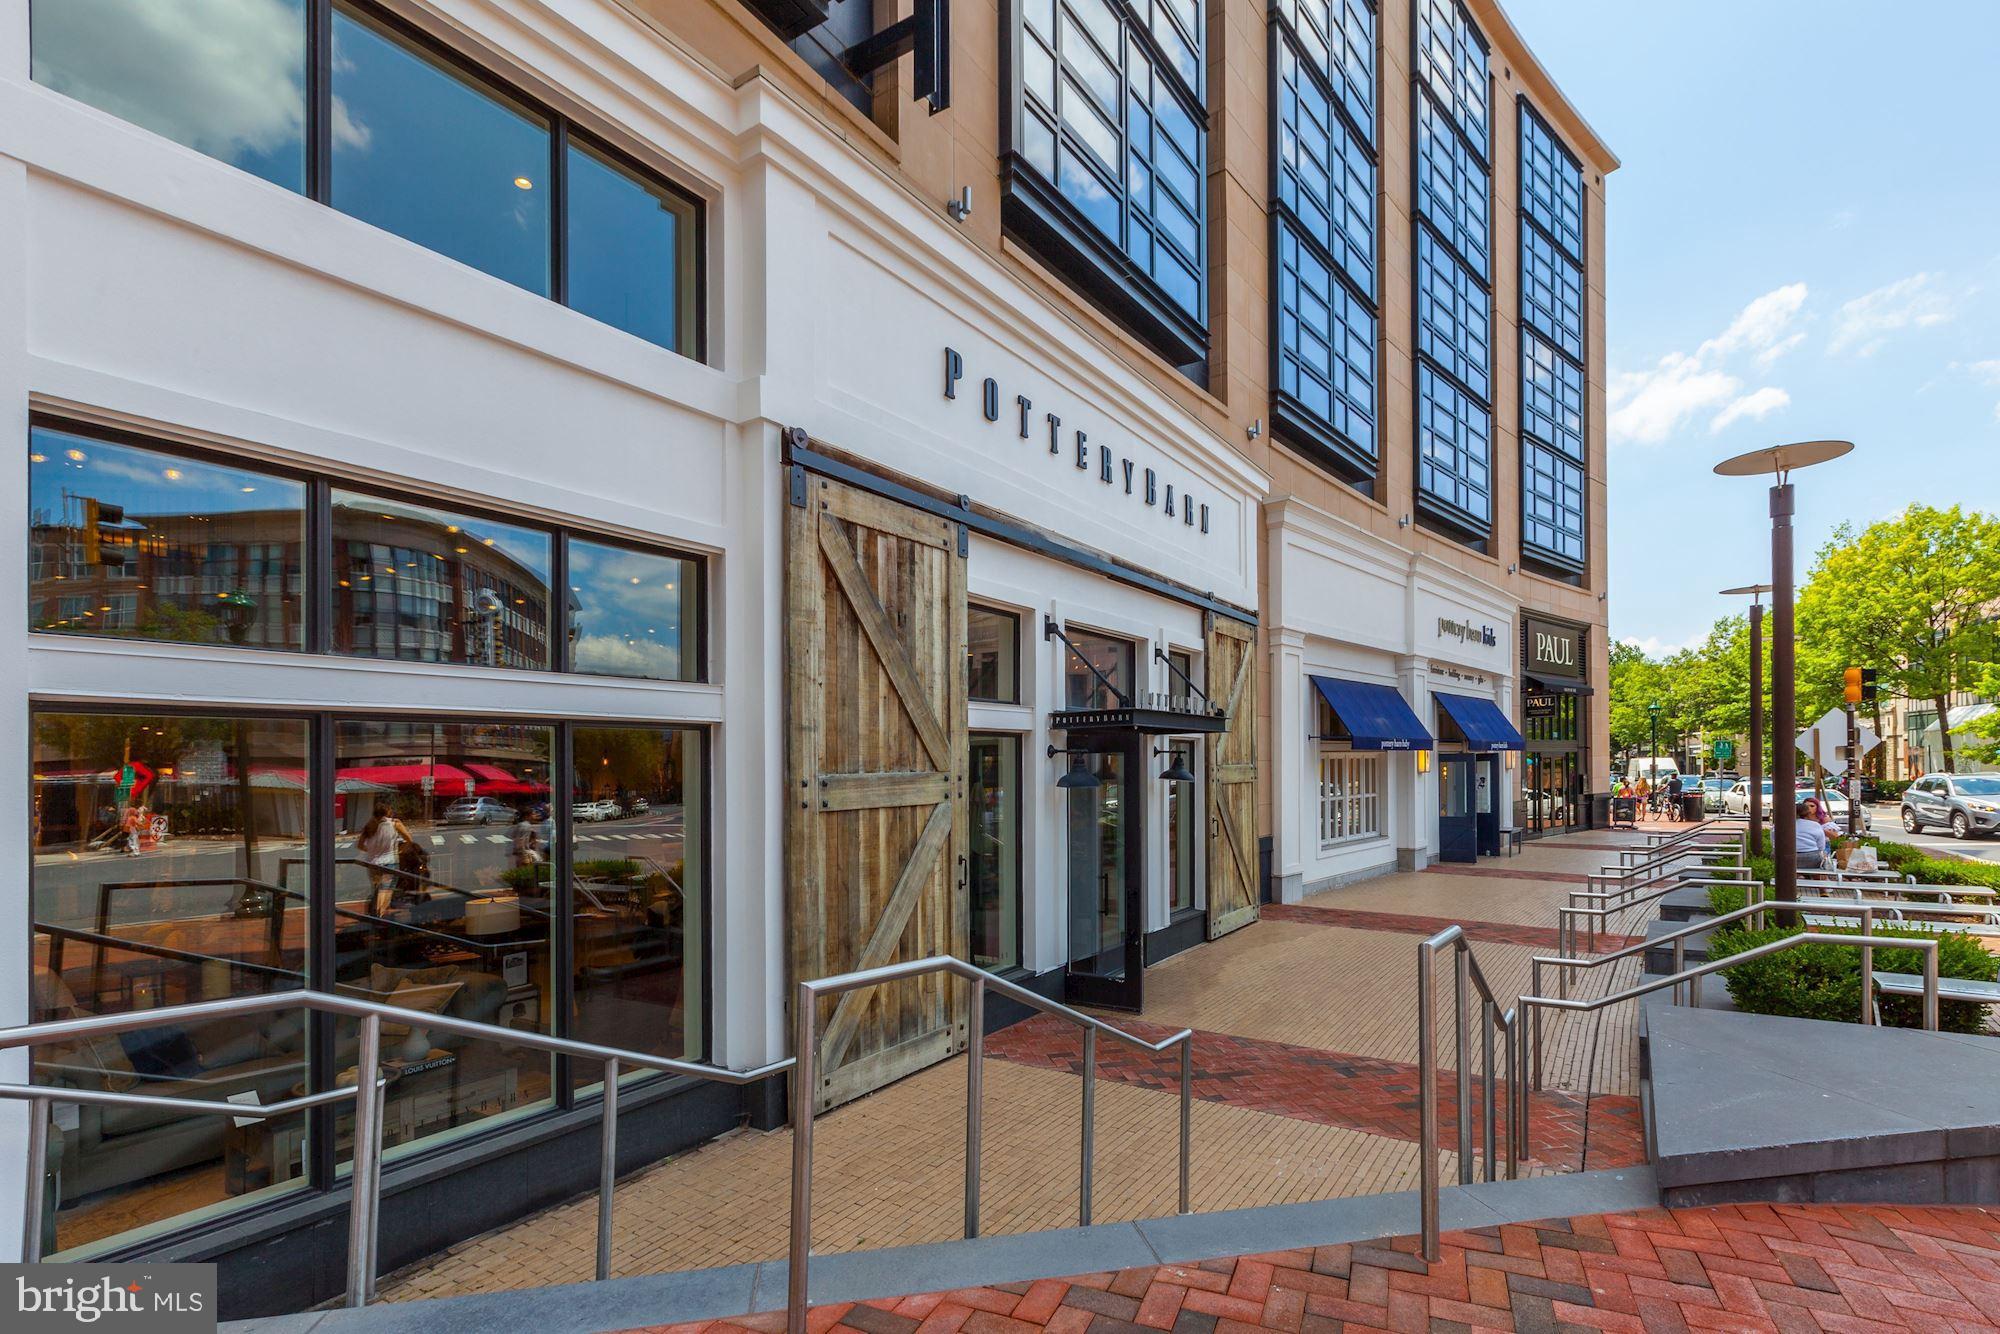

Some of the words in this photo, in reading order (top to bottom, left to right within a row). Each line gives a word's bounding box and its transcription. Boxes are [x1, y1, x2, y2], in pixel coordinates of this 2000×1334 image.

[1536, 632, 1574, 666] PAUL
[1526, 697, 1555, 708] PAUL
[404, 1065, 425, 1075] LOUIS
[425, 1058, 453, 1070] VUITTON
